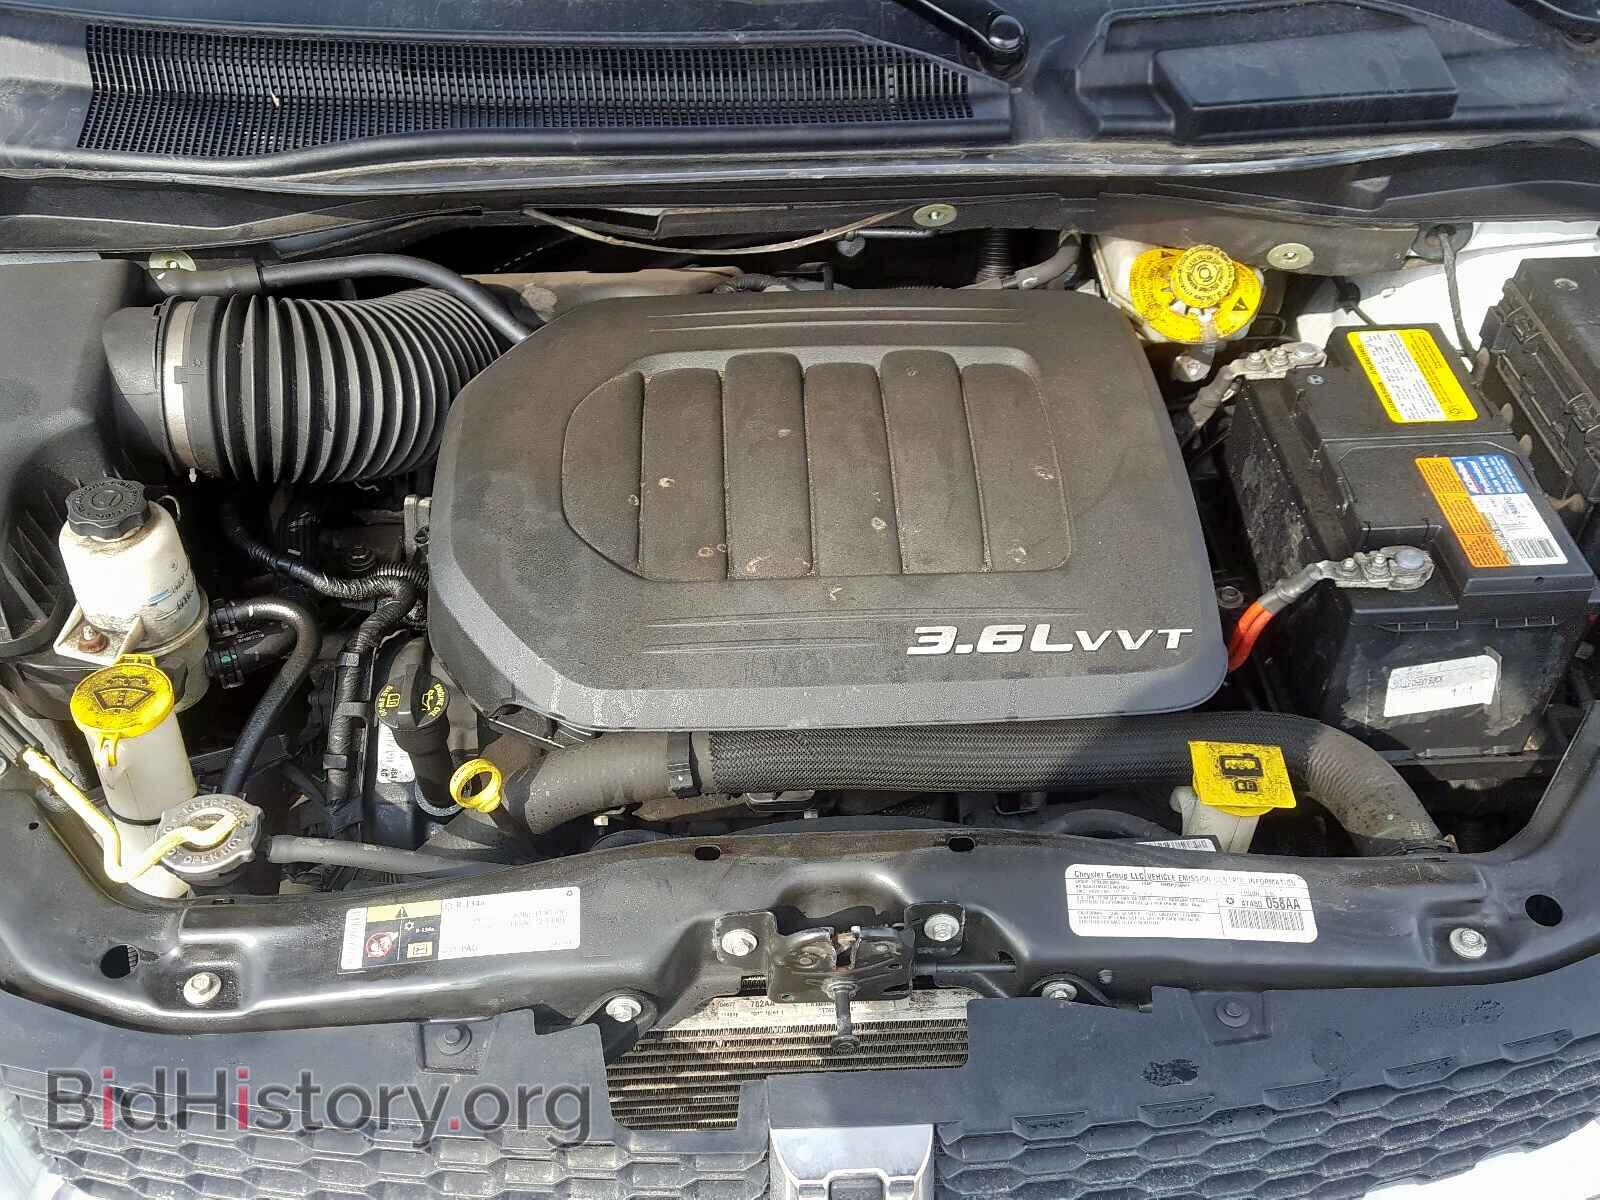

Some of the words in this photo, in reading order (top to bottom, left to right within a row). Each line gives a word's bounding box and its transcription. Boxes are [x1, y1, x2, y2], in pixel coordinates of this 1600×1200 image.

[906, 623, 1075, 656] 3.6L
[1074, 628, 1194, 651] VVT
[1074, 870, 1105, 880] Chrysler
[1106, 871, 1128, 880] Group
[1130, 872, 1145, 880] LLC
[1146, 872, 1176, 882] VEHICLE
